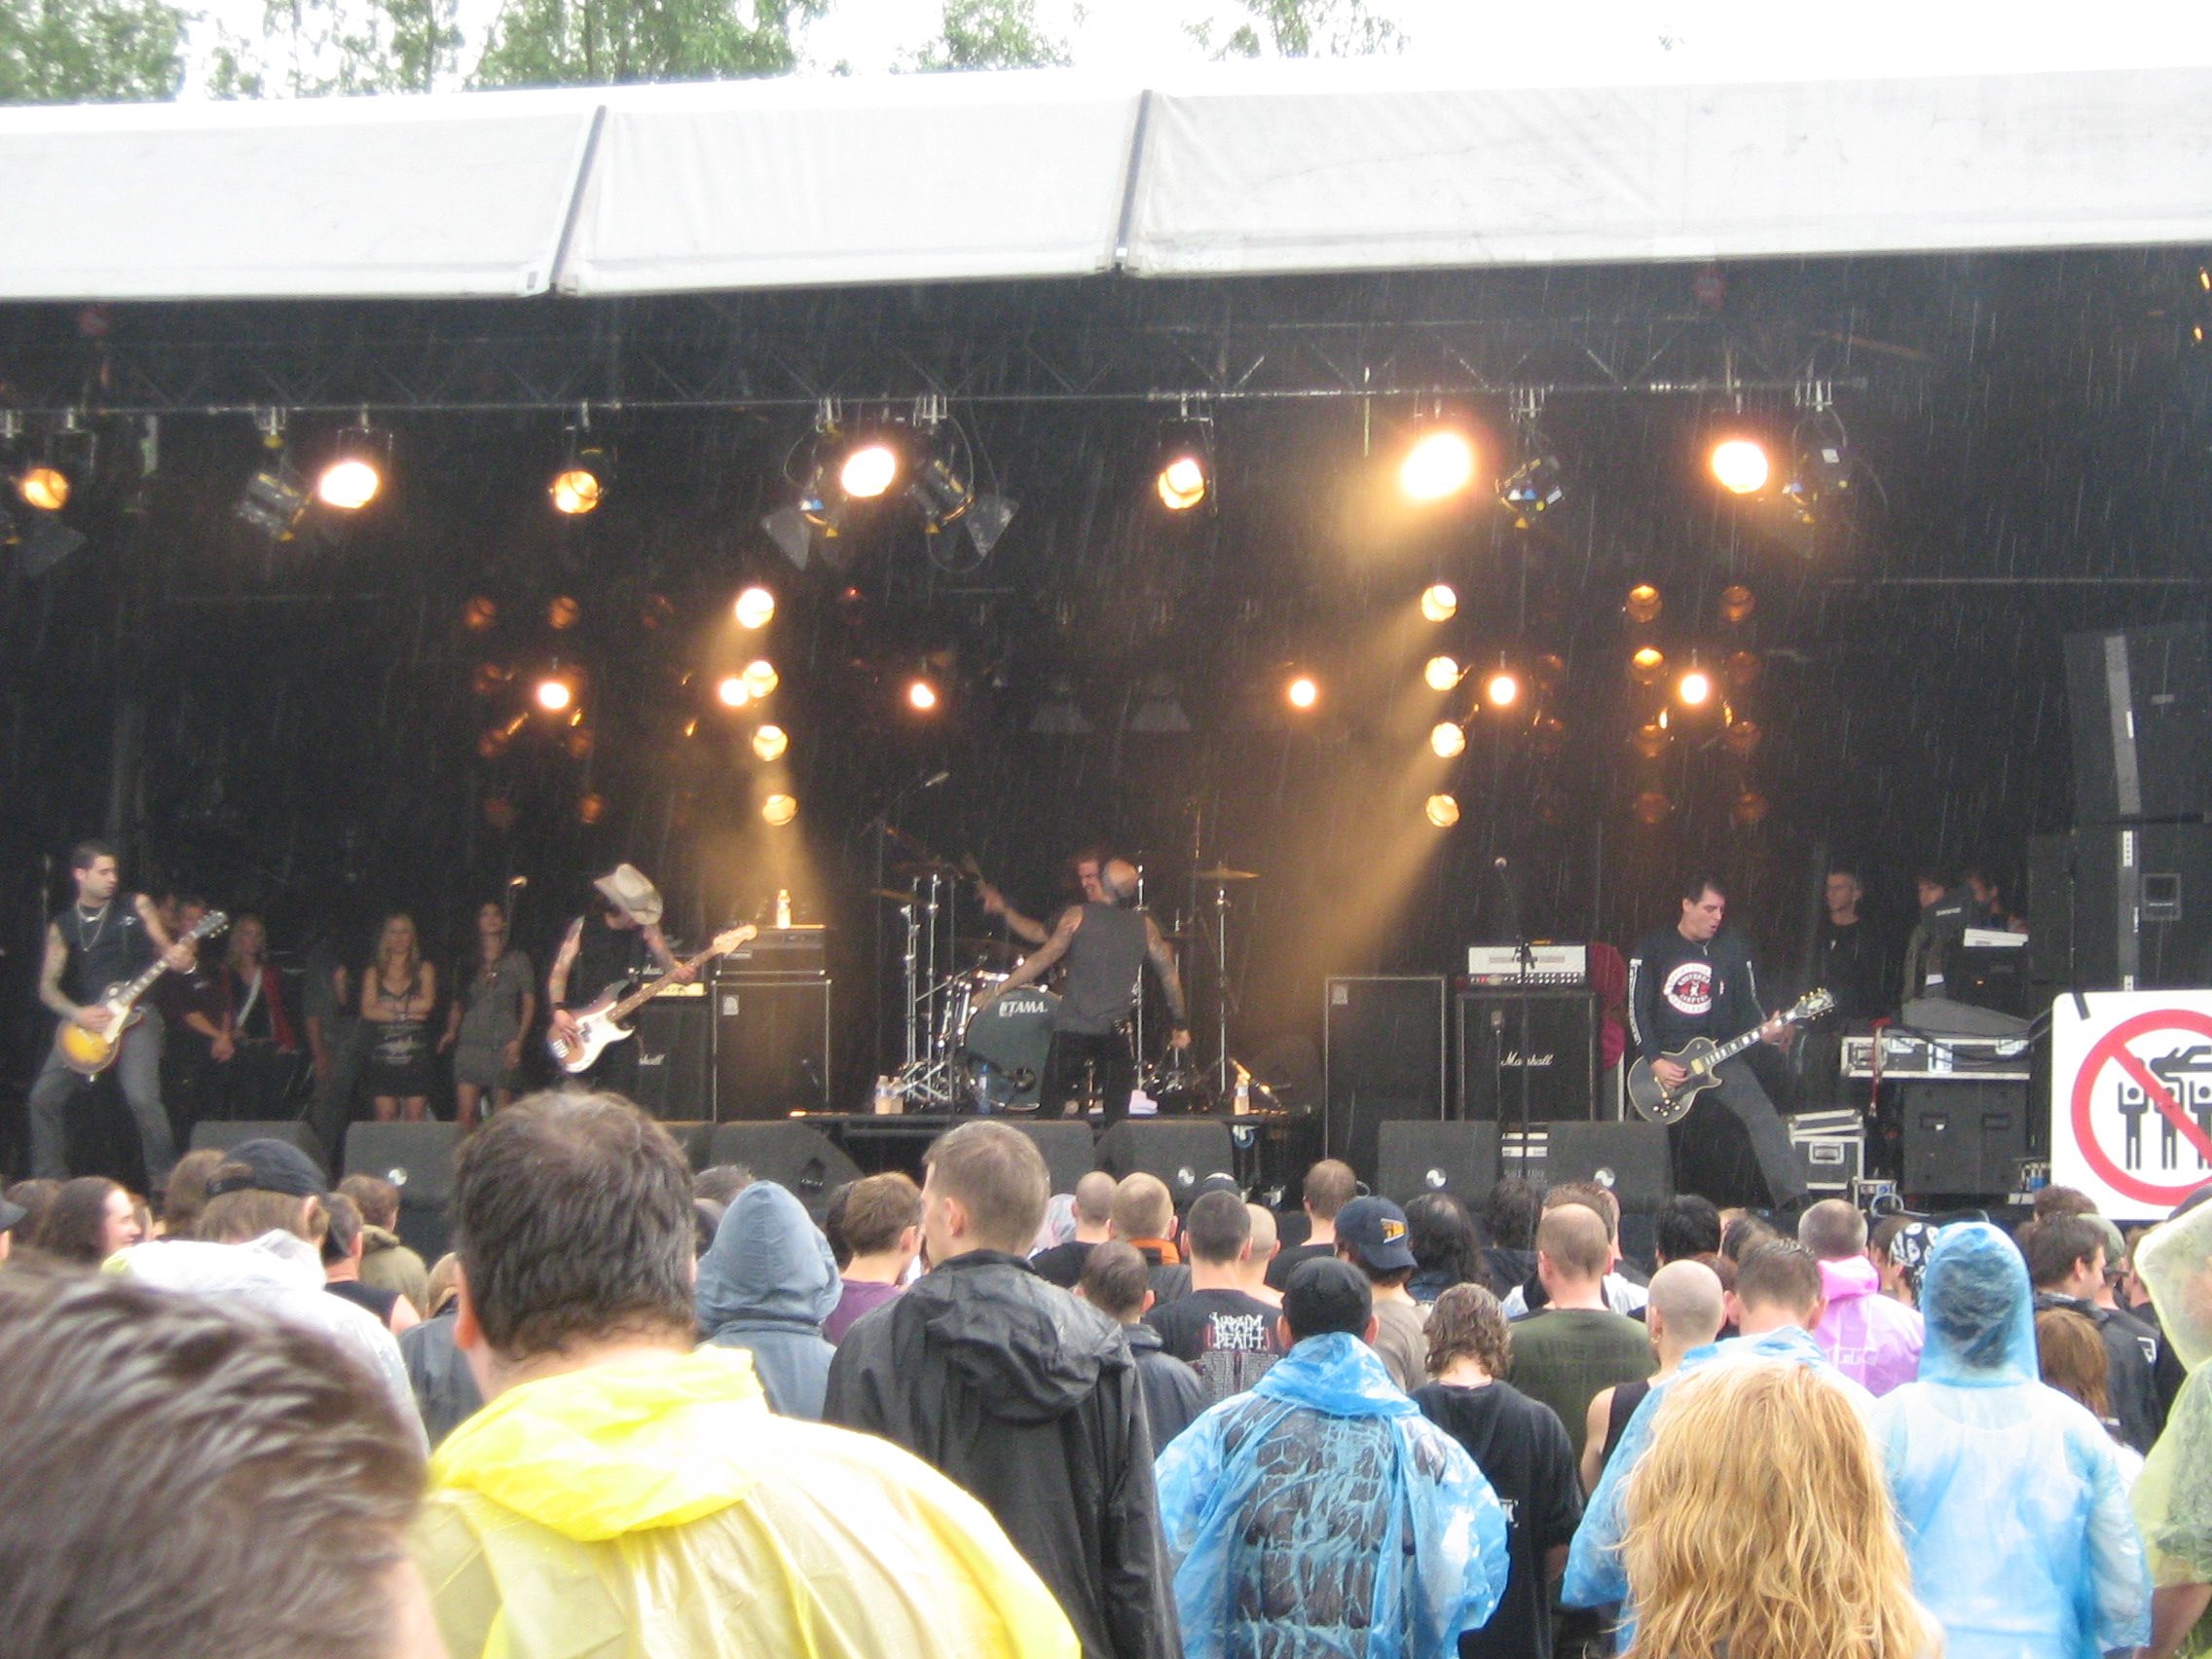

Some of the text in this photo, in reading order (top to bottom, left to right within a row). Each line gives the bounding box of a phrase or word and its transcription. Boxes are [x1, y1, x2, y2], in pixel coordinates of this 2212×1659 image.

[1008, 1001, 1049, 1014] TAMA
[1500, 1051, 1554, 1066] Mashall
[1212, 1328, 1265, 1350] DEATH
